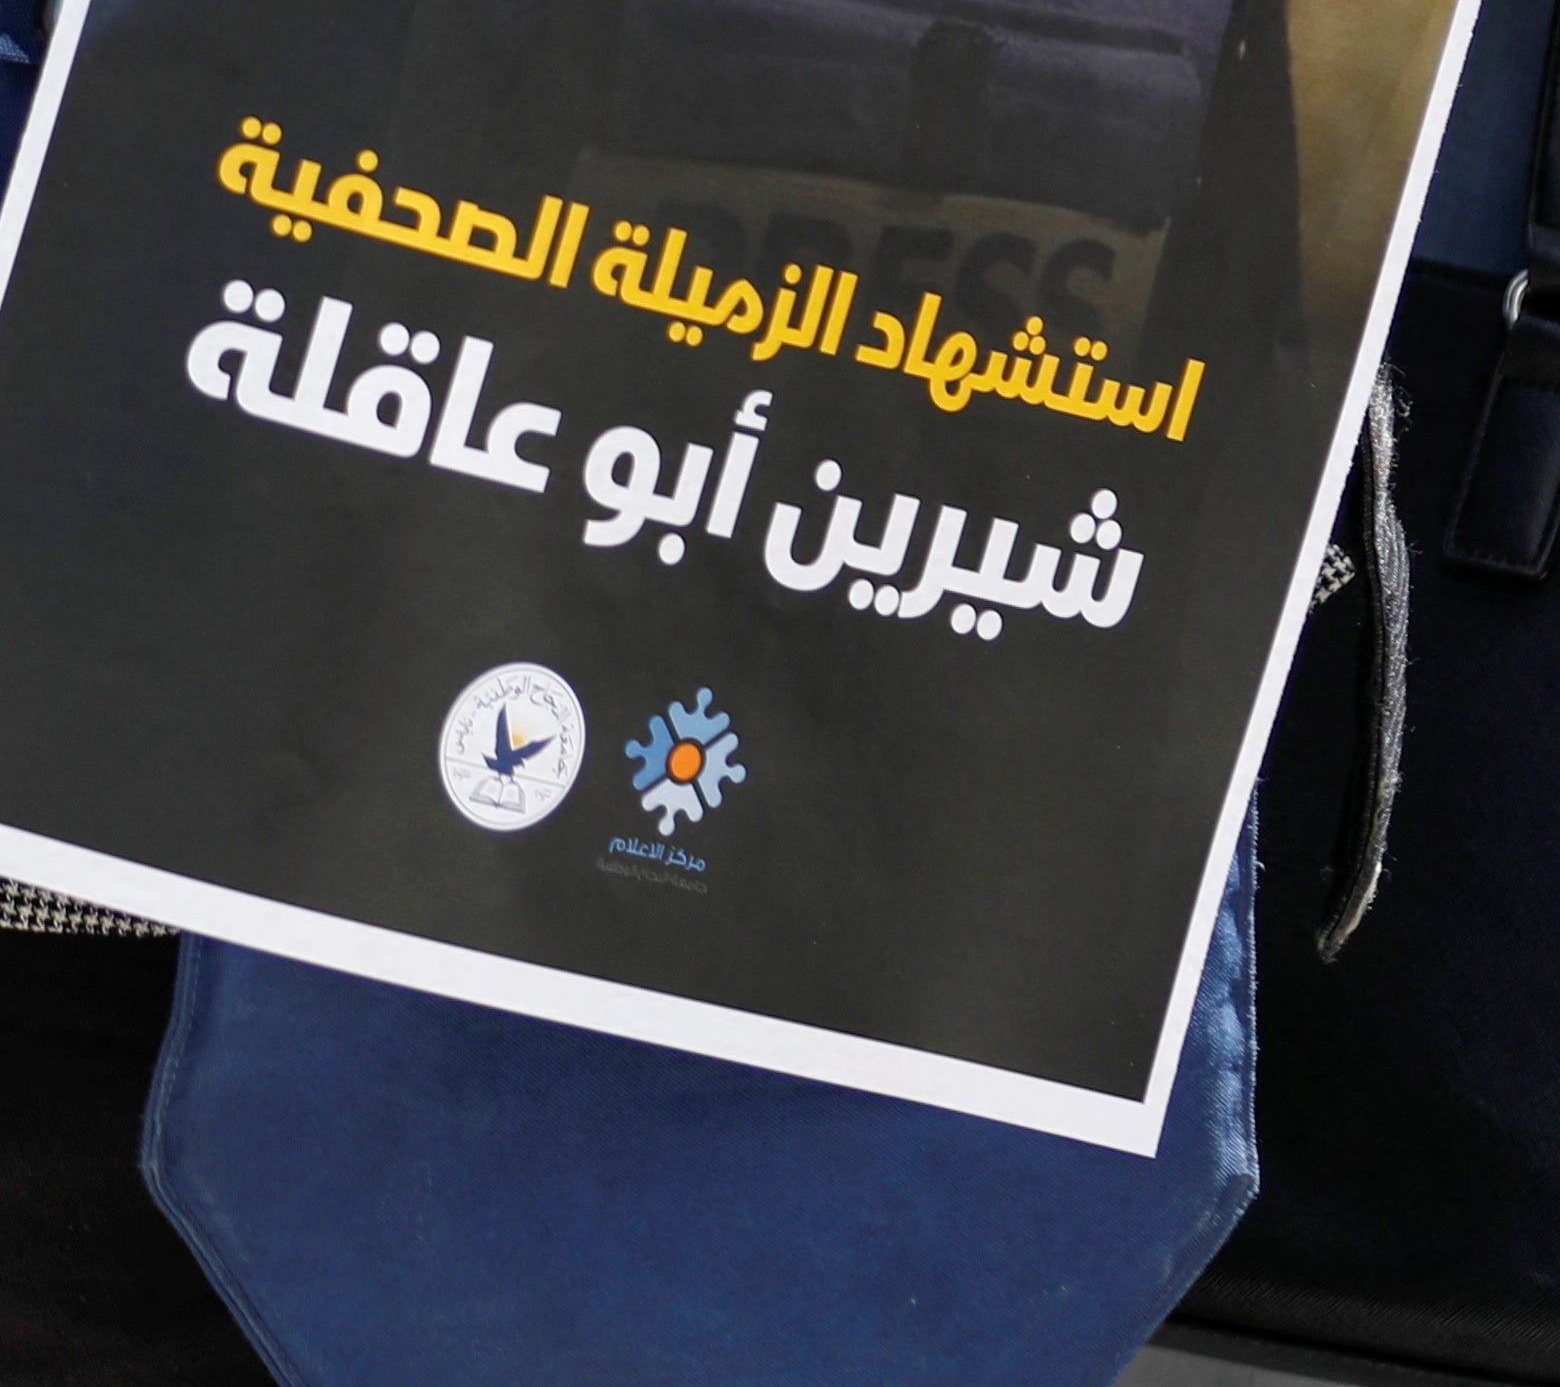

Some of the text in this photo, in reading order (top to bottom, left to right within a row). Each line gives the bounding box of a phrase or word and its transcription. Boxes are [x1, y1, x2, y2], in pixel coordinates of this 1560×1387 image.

[216, 115, 1207, 443] استشهاد الزميلة الصحفية
[185, 278, 1145, 642] شيرين أبو عاقلة
[664, 845, 706, 872] مركز
